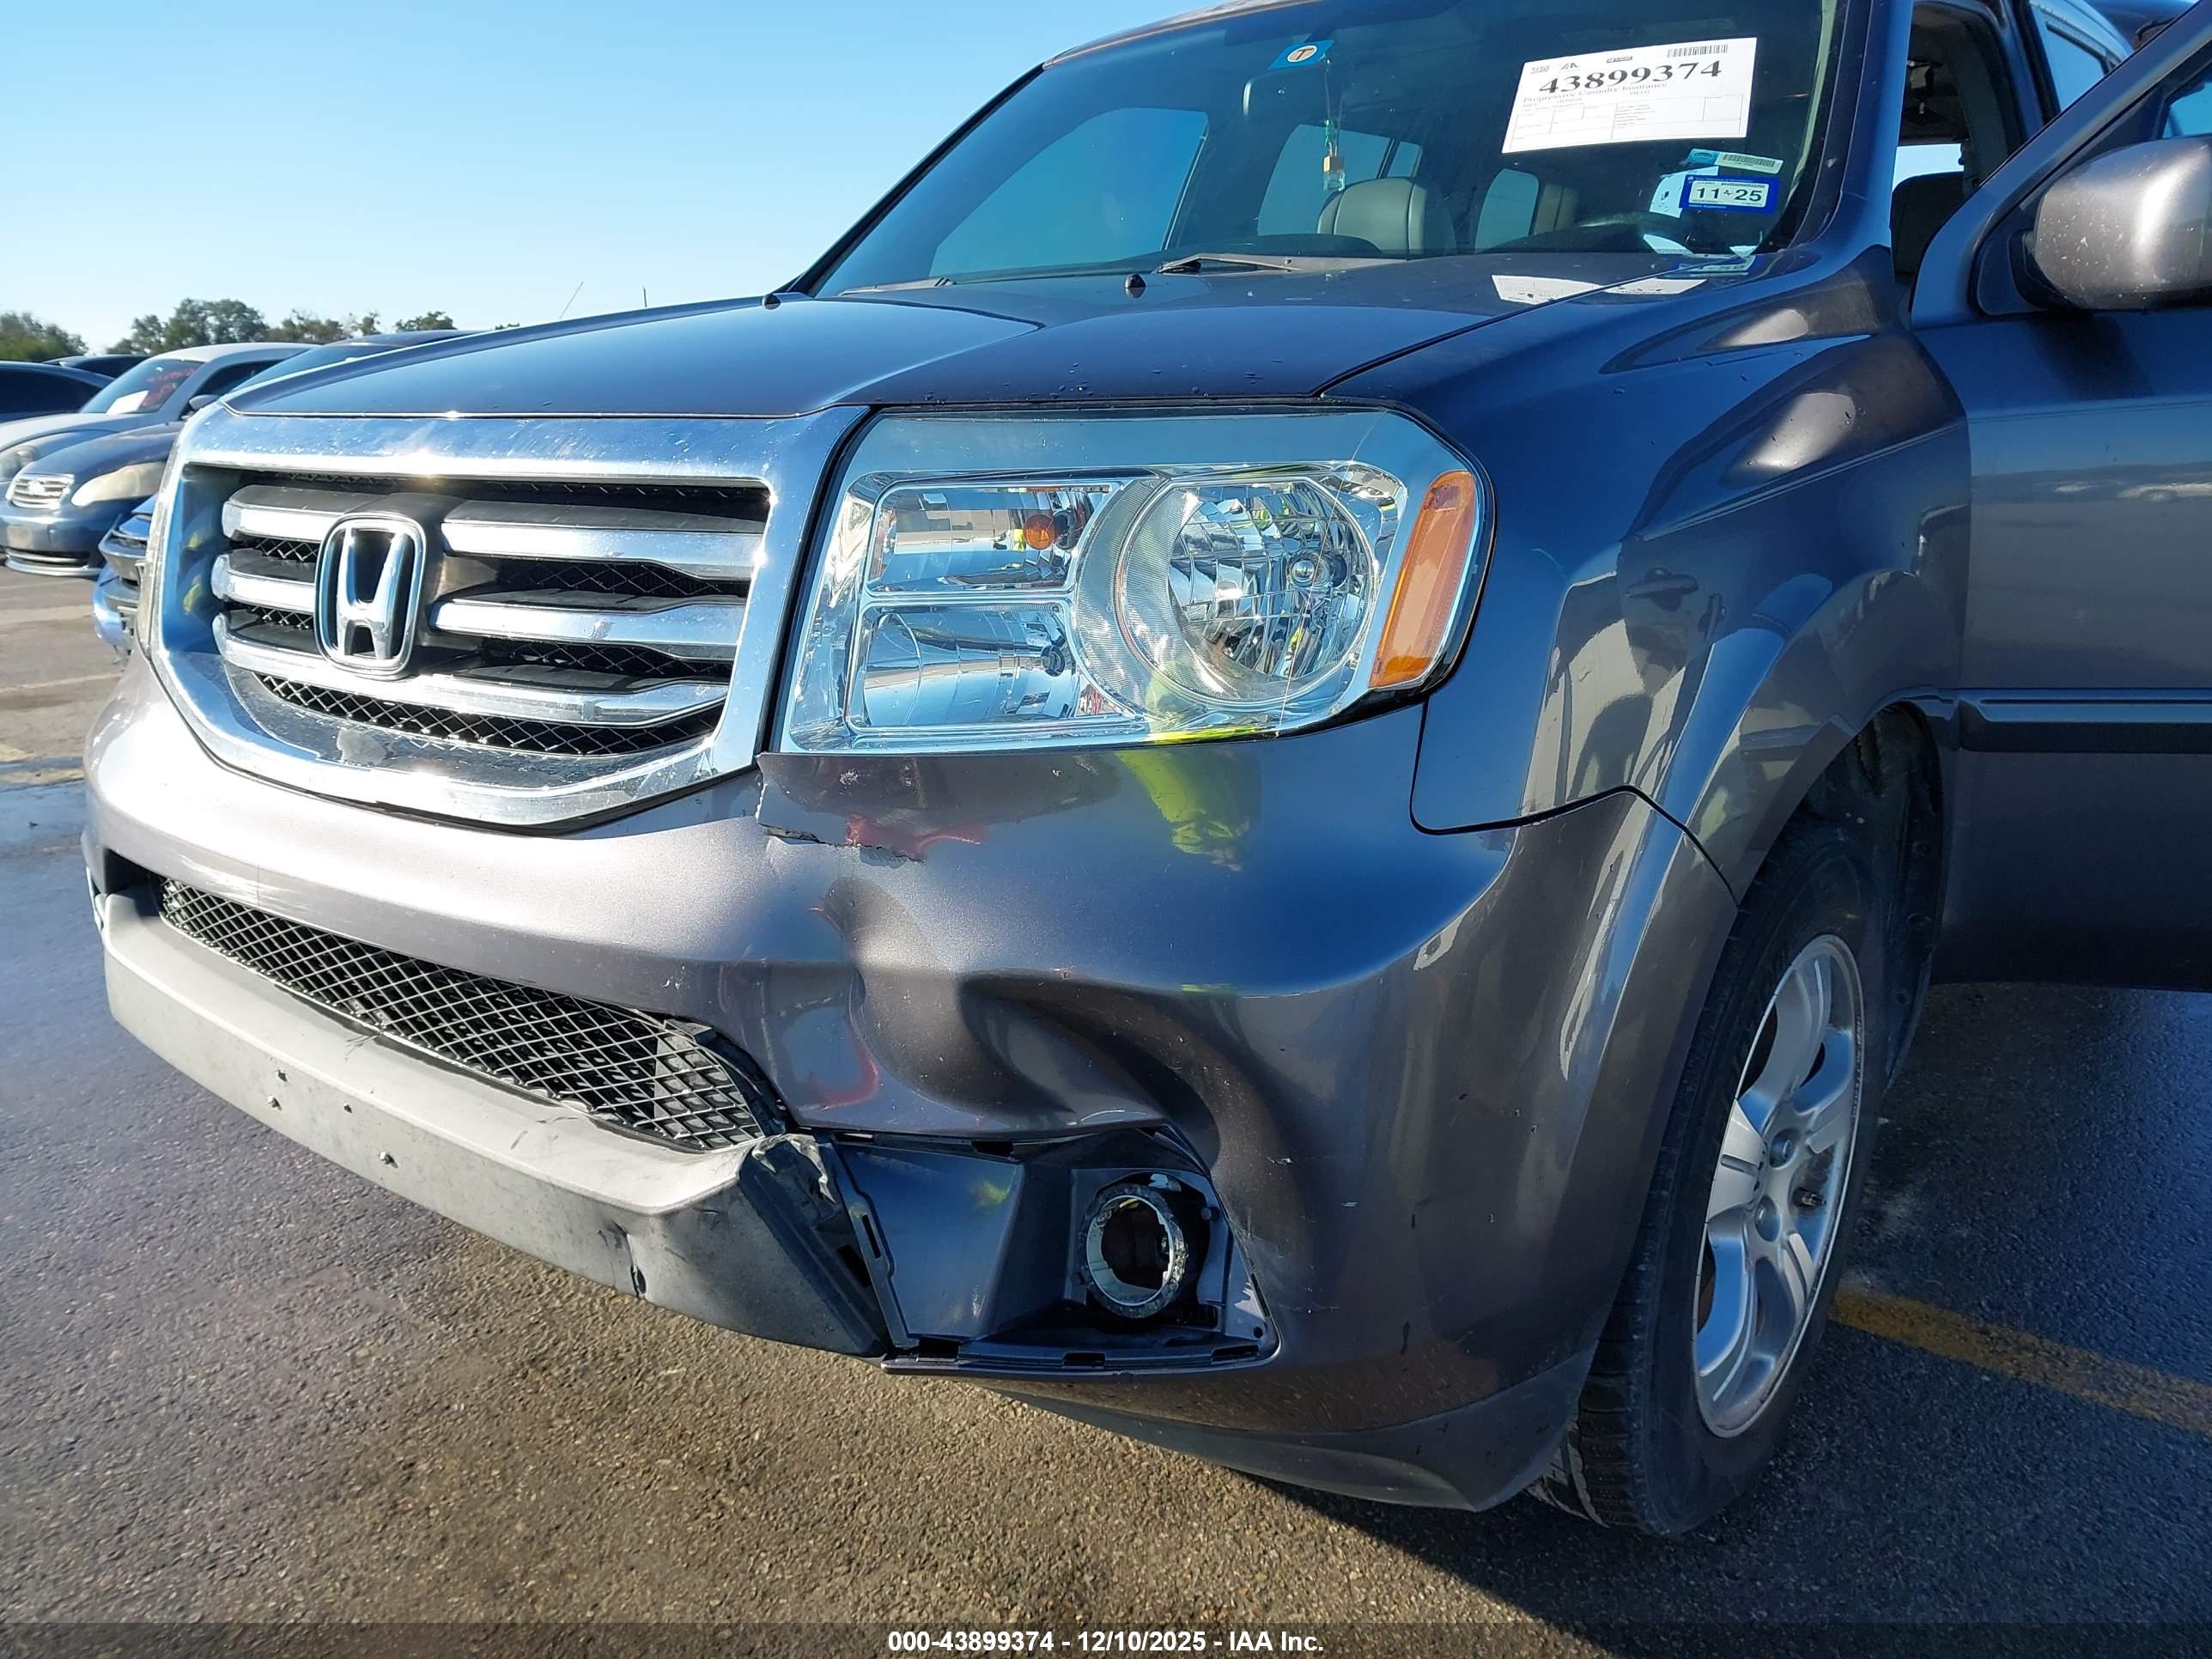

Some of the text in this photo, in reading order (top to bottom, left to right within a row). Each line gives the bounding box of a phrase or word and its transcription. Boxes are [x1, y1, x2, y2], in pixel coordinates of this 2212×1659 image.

[1296, 46, 1314, 61] T
[1539, 59, 1722, 94] 43899374
[1696, 187, 1763, 202] 11 25
